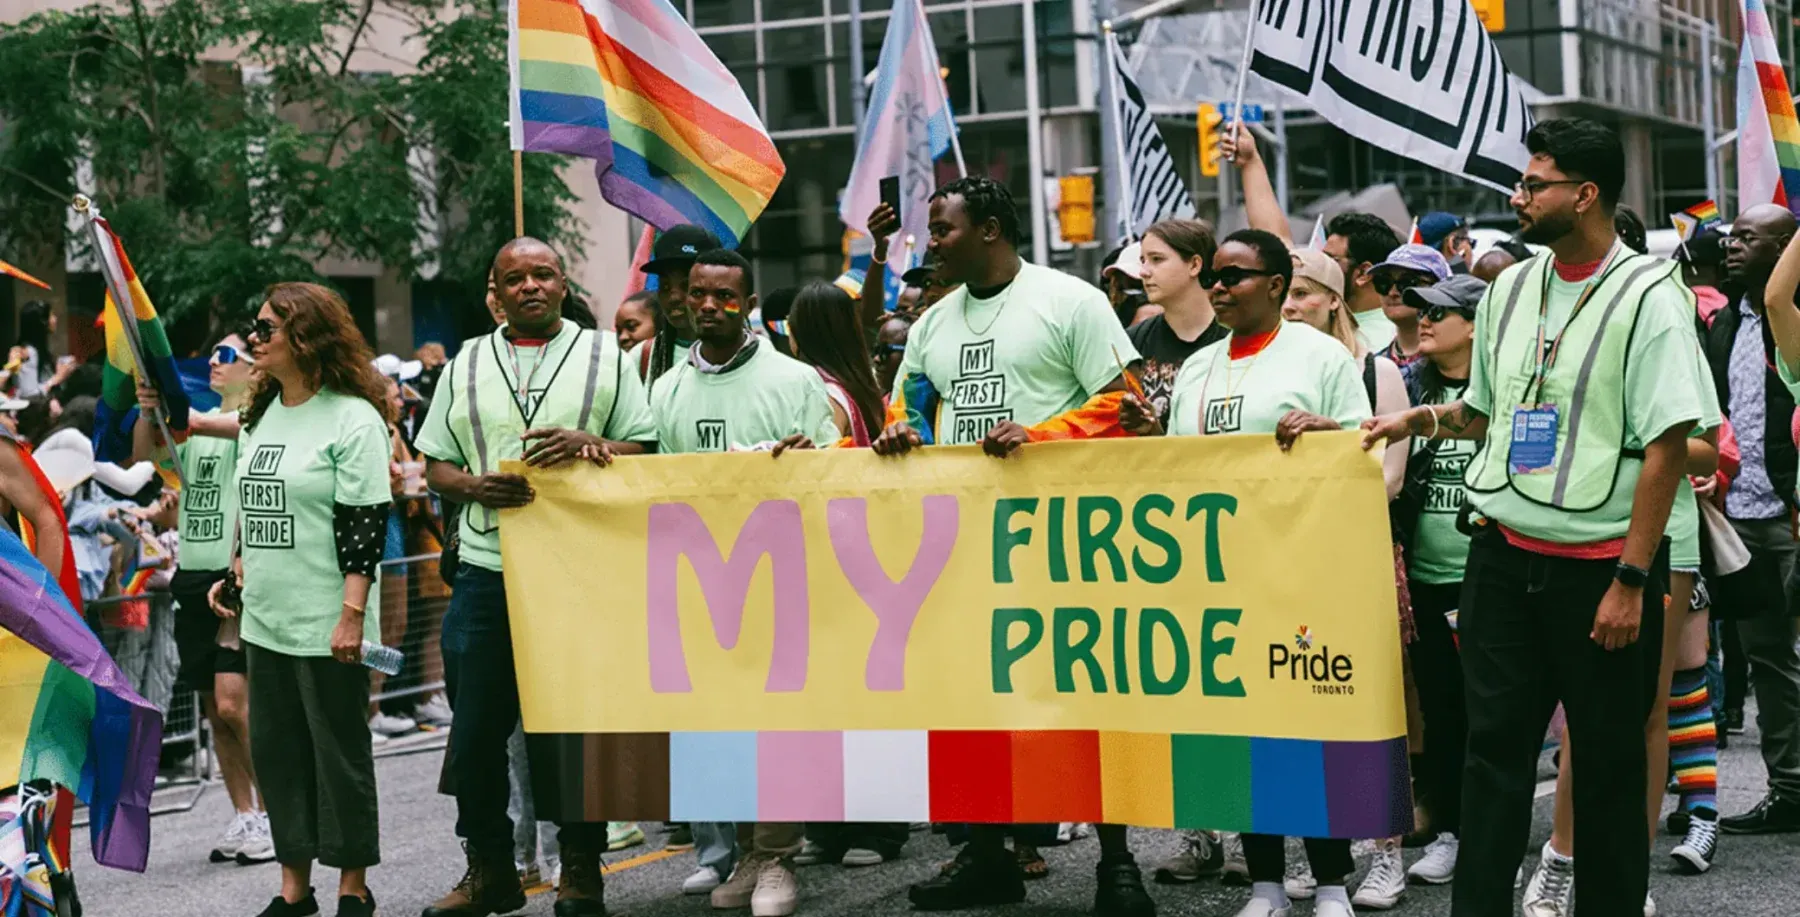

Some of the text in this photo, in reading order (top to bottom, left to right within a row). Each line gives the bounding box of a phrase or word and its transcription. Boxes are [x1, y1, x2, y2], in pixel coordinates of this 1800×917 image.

[965, 346, 990, 369] MY
[955, 381, 1000, 404] FIRST
[1210, 402, 1237, 428] MY
[697, 426, 721, 449] MY
[957, 416, 1007, 443] PRID
[254, 450, 279, 470] MY
[244, 483, 280, 507] FIRST
[187, 518, 219, 537] PRIDE
[249, 520, 289, 543] PRIDE
[992, 493, 1238, 584] FIRST
[647, 494, 959, 693] MY
[991, 607, 1247, 698] PRIDE
[1269, 643, 1353, 682] Pride
[1312, 685, 1354, 695] TORONTO
